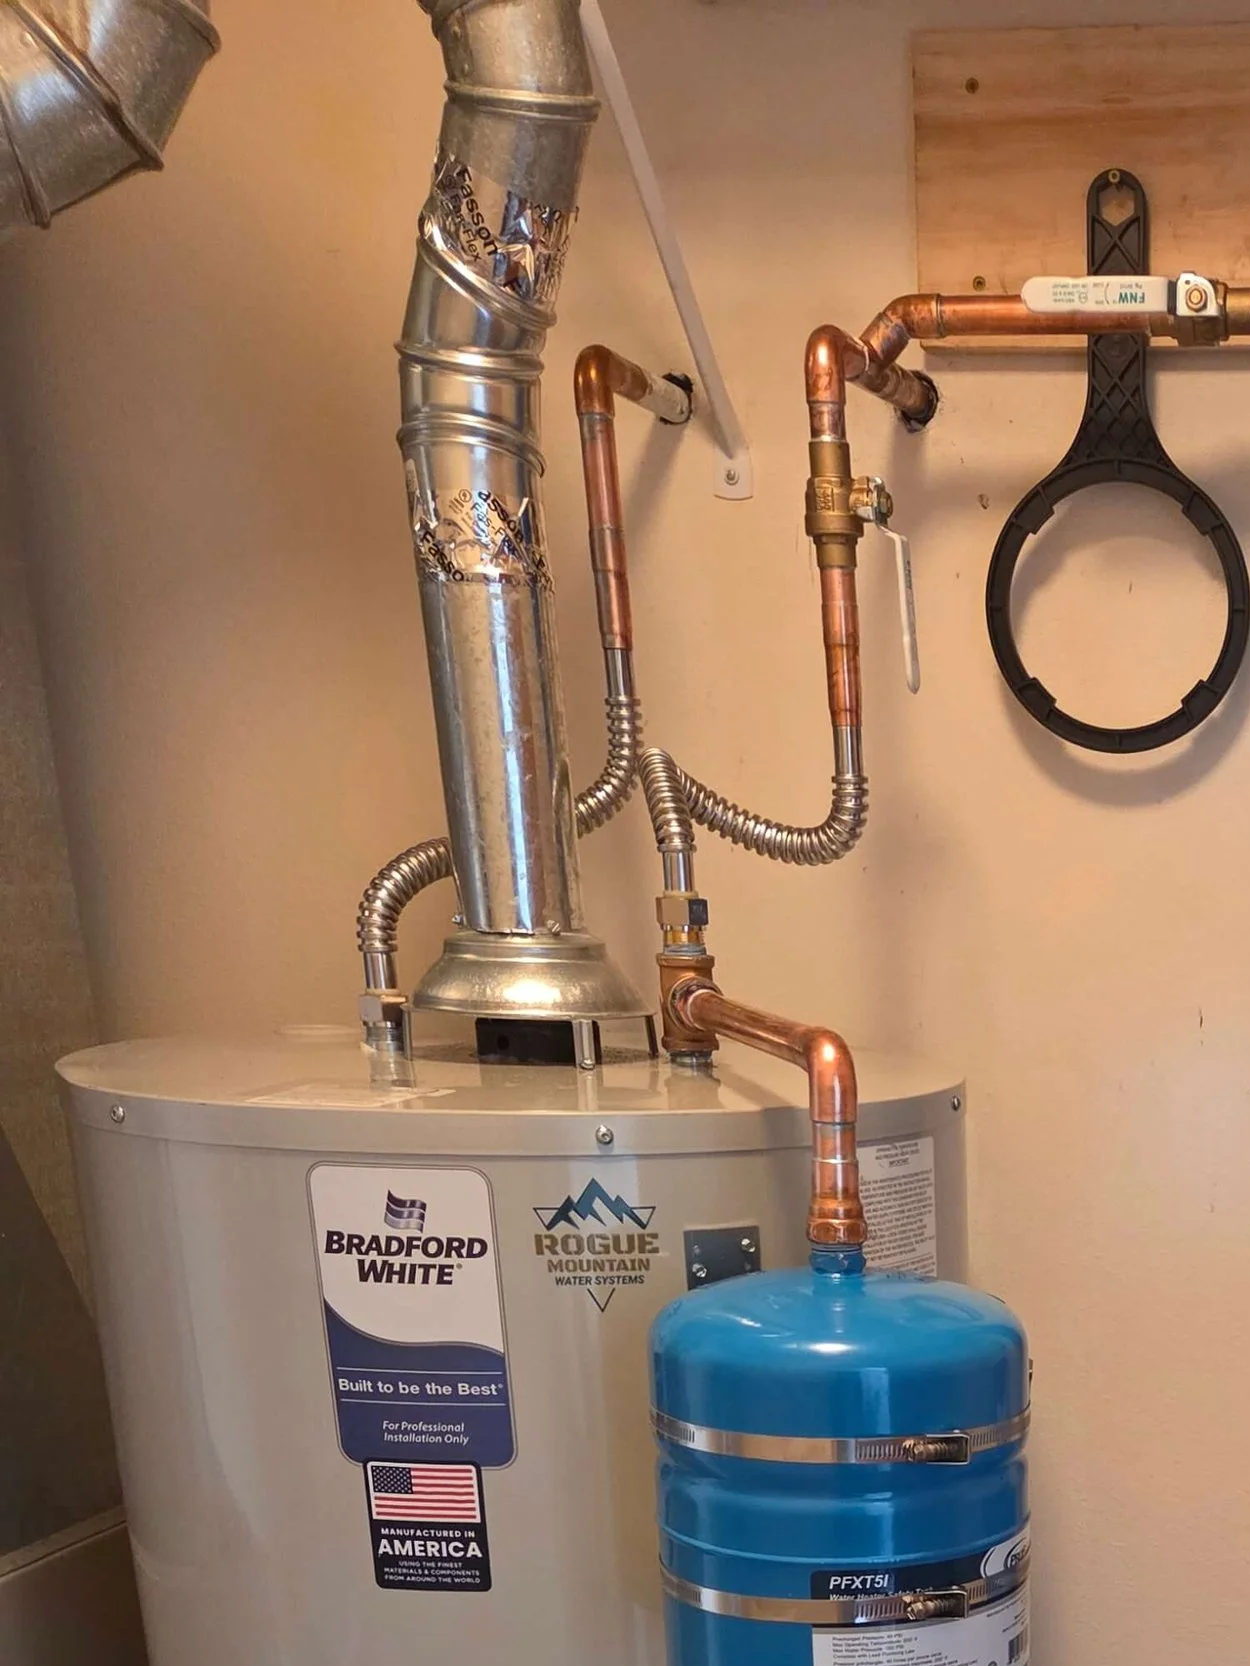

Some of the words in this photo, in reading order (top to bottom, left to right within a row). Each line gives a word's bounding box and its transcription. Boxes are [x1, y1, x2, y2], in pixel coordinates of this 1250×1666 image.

[1118, 292, 1146, 304] FNW
[324, 1230, 488, 1259] BRADFORD
[534, 1233, 660, 1256] ROGUE
[357, 1259, 455, 1285] WHITE
[547, 1258, 651, 1273] MOUNTAIN
[555, 1276, 592, 1286] WATER
[594, 1275, 645, 1286] SYSTEMS
[338, 1378, 374, 1393] Built
[377, 1381, 394, 1394] to
[399, 1382, 420, 1395] be
[425, 1383, 452, 1395] the
[458, 1383, 498, 1396] Best
[382, 1420, 400, 1431] For
[401, 1421, 465, 1433] Professional
[383, 1432, 442, 1443] Installation
[444, 1434, 469, 1446] Only
[381, 1527, 461, 1538] MANUFACTURED
[378, 1538, 483, 1558] AMERICA
[384, 1567, 422, 1575] MATERIALS
[431, 1569, 480, 1577] COMPONENTS
